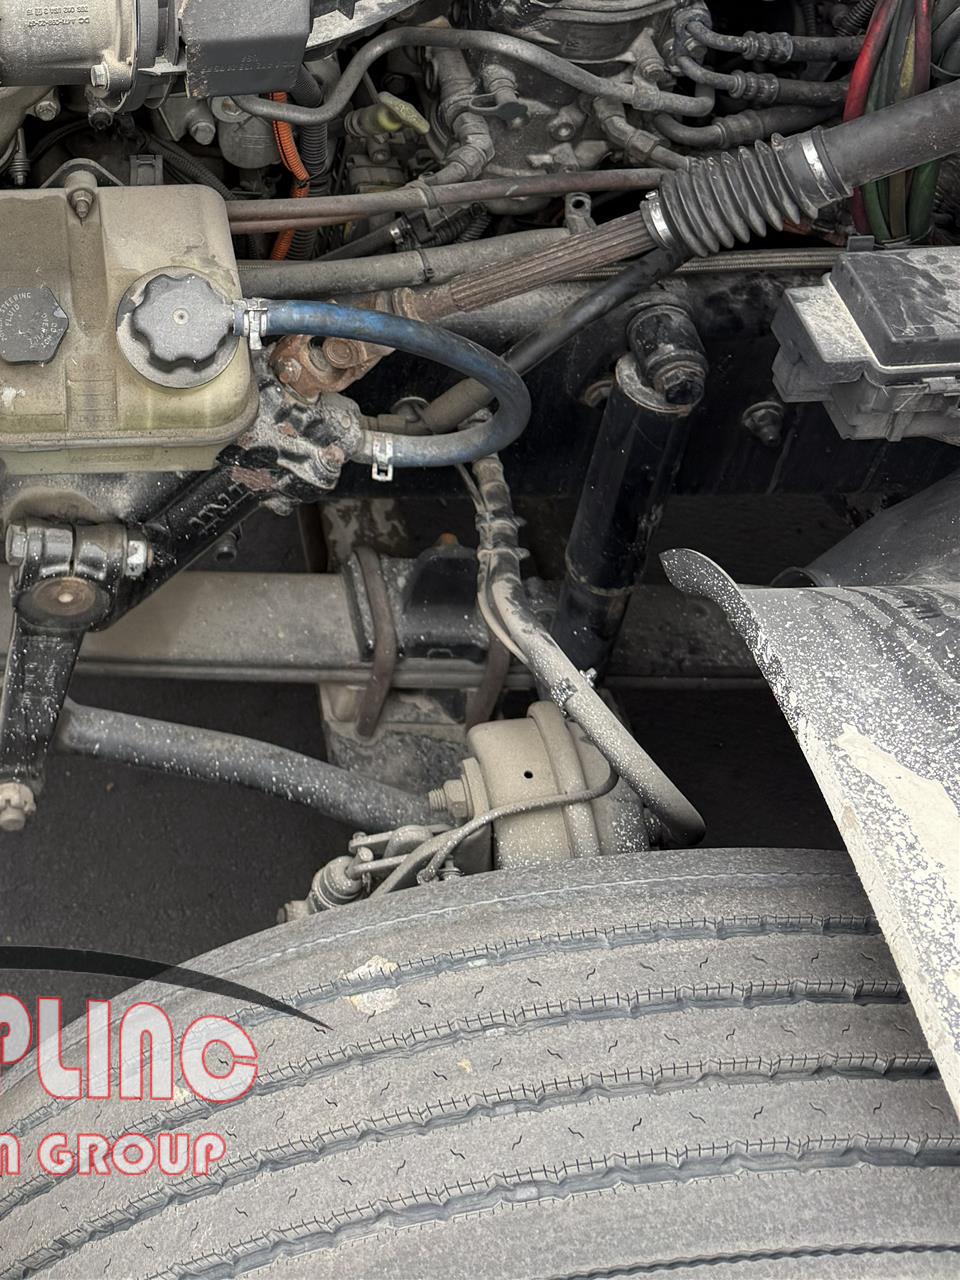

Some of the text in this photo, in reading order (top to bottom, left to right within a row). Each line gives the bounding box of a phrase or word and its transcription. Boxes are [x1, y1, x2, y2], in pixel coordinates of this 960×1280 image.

[0, 292, 32, 314] STEERING
[5, 303, 20, 327] FLUID
[41, 322, 58, 349] DO NOT
